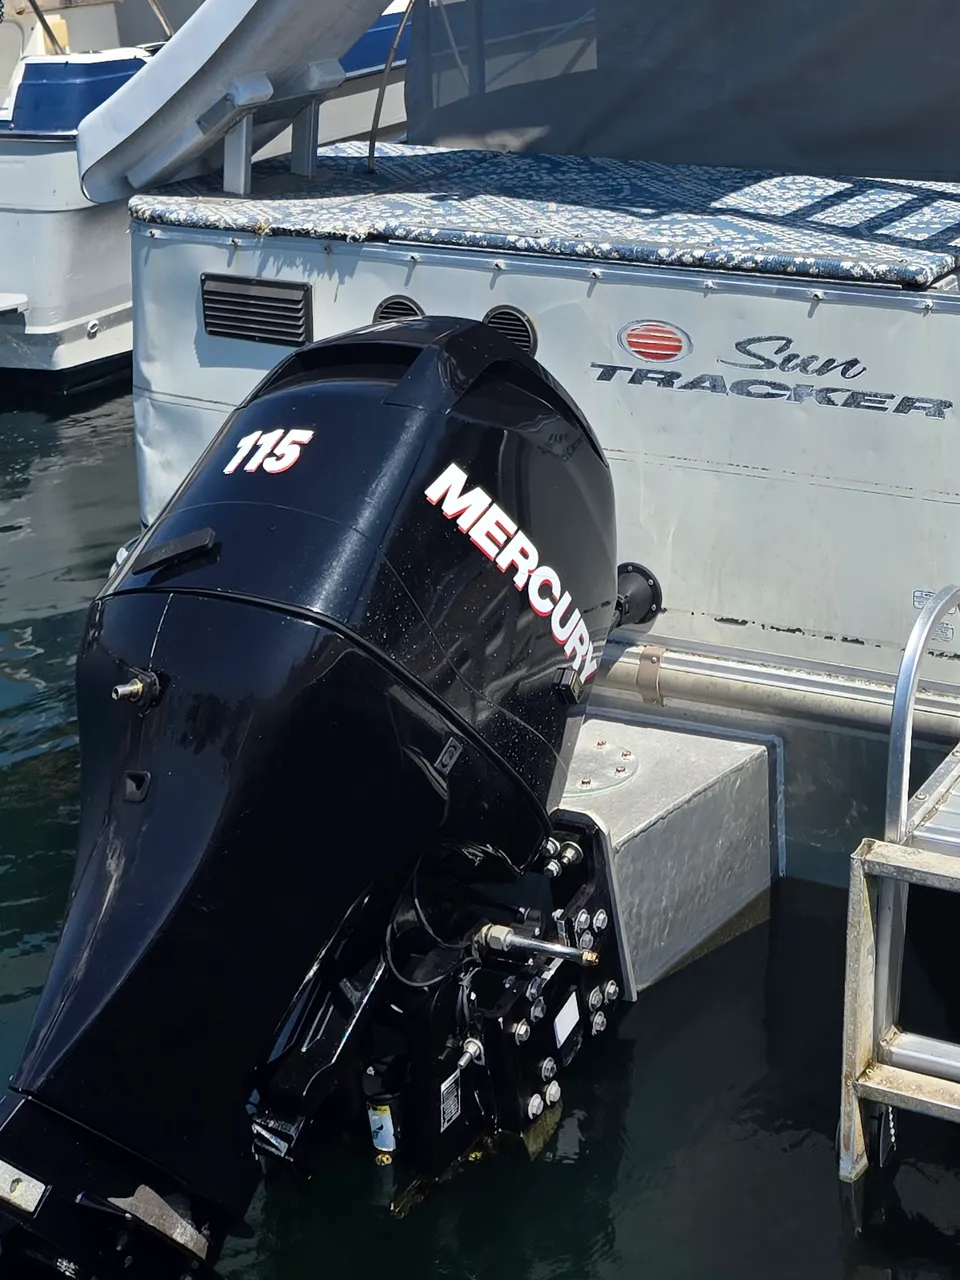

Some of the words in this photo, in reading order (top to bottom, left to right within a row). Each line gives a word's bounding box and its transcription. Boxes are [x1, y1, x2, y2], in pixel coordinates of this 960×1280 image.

[716, 335, 867, 380] Sun
[589, 362, 954, 420] TRACKER
[223, 429, 315, 474] 115
[424, 463, 598, 684] MERCURY
